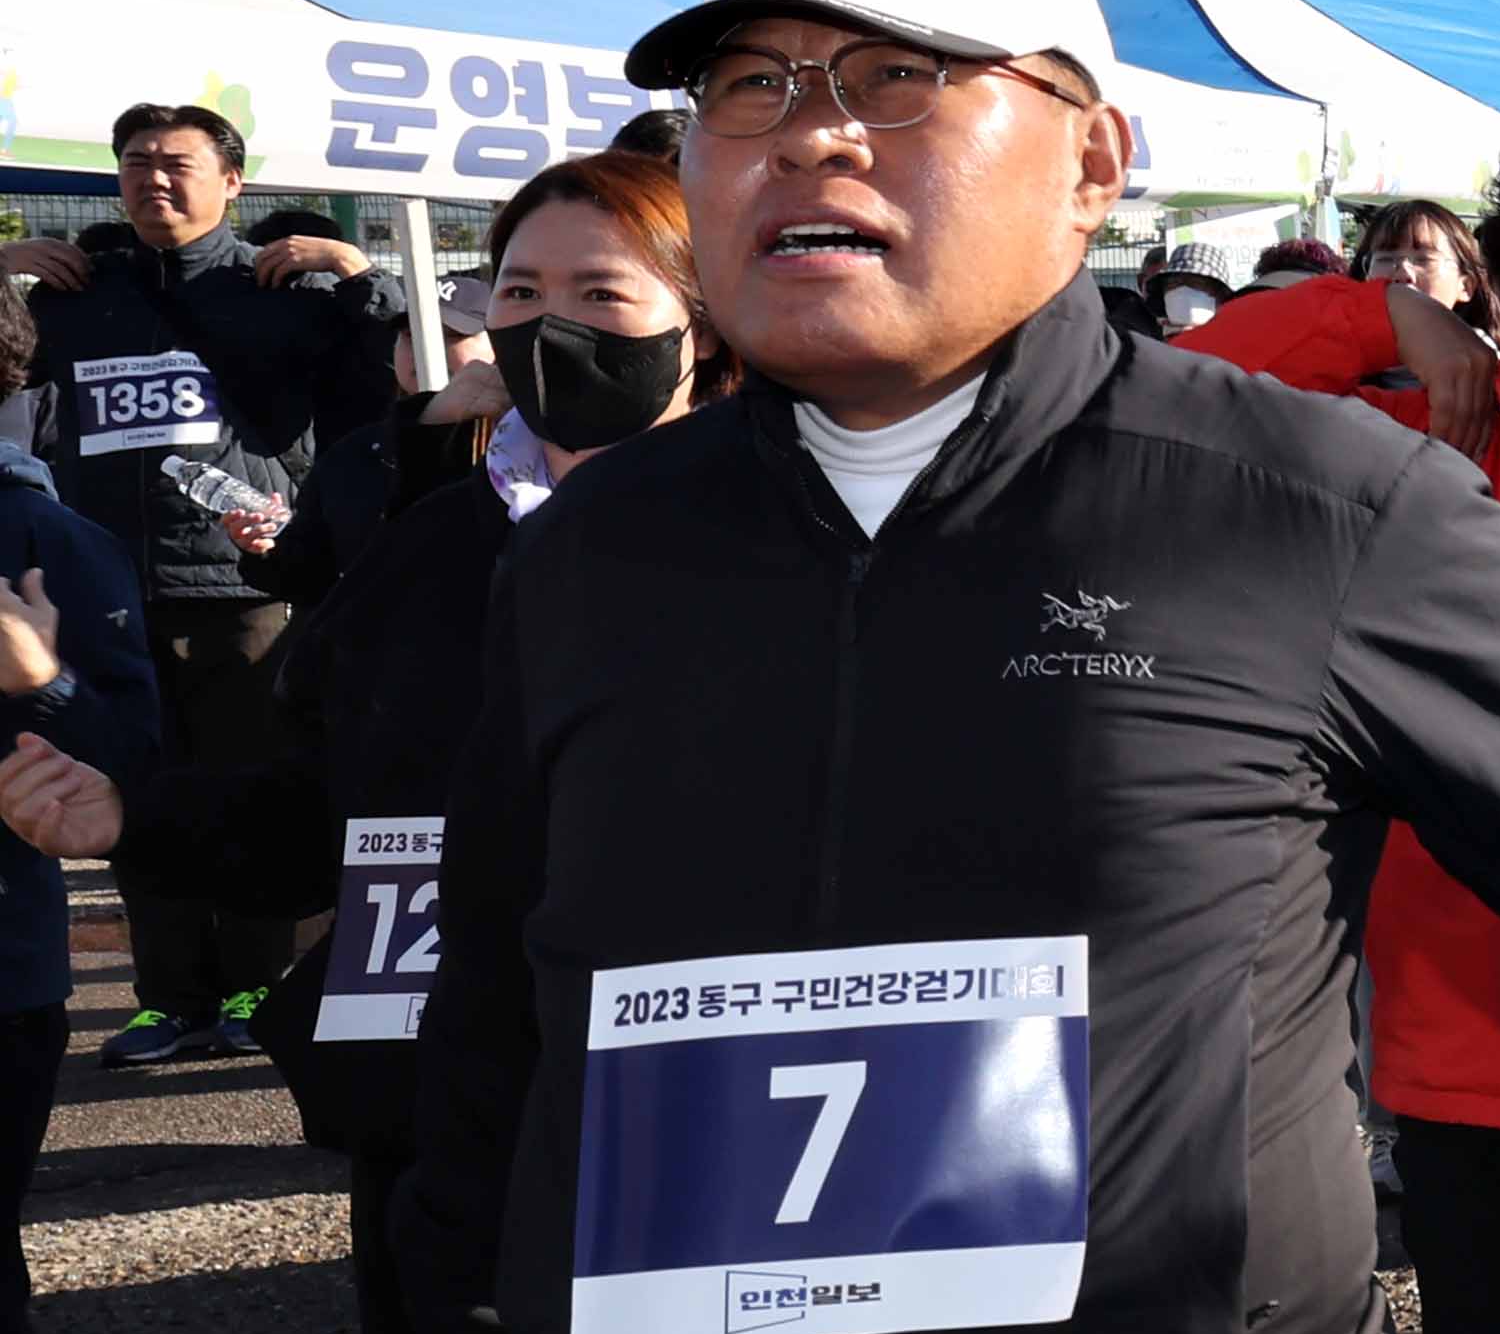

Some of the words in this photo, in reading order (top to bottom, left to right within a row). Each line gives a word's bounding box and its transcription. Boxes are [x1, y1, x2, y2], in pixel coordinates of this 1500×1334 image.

[326, 40, 685, 179] 운영본
[90, 376, 205, 426] 1358
[1002, 651, 1155, 679] ARC'TERYX
[358, 833, 407, 853] 2023
[614, 987, 690, 1027] 2023
[698, 985, 762, 1017] 동구
[768, 1059, 867, 1226] 7
[739, 1281, 881, 1311] 인천일보
